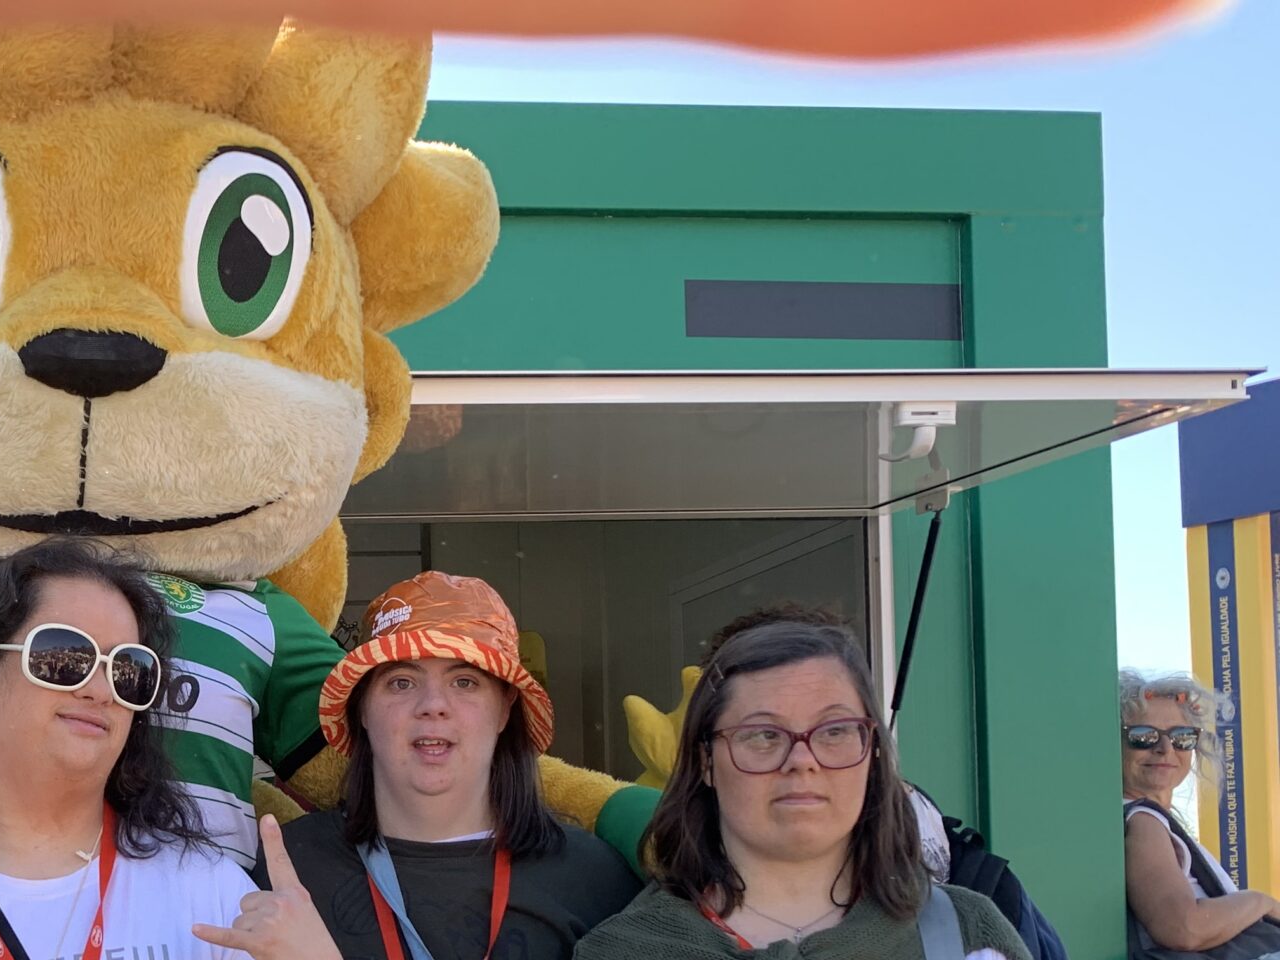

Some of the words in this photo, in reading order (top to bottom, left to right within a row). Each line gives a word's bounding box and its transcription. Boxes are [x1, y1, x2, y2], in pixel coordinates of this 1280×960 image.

[1220, 596, 1229, 645] IGUALDADE
[1222, 645, 1231, 669] PELA
[1227, 790, 1236, 811] QUE
[1227, 812, 1238, 847] MÚSICA
